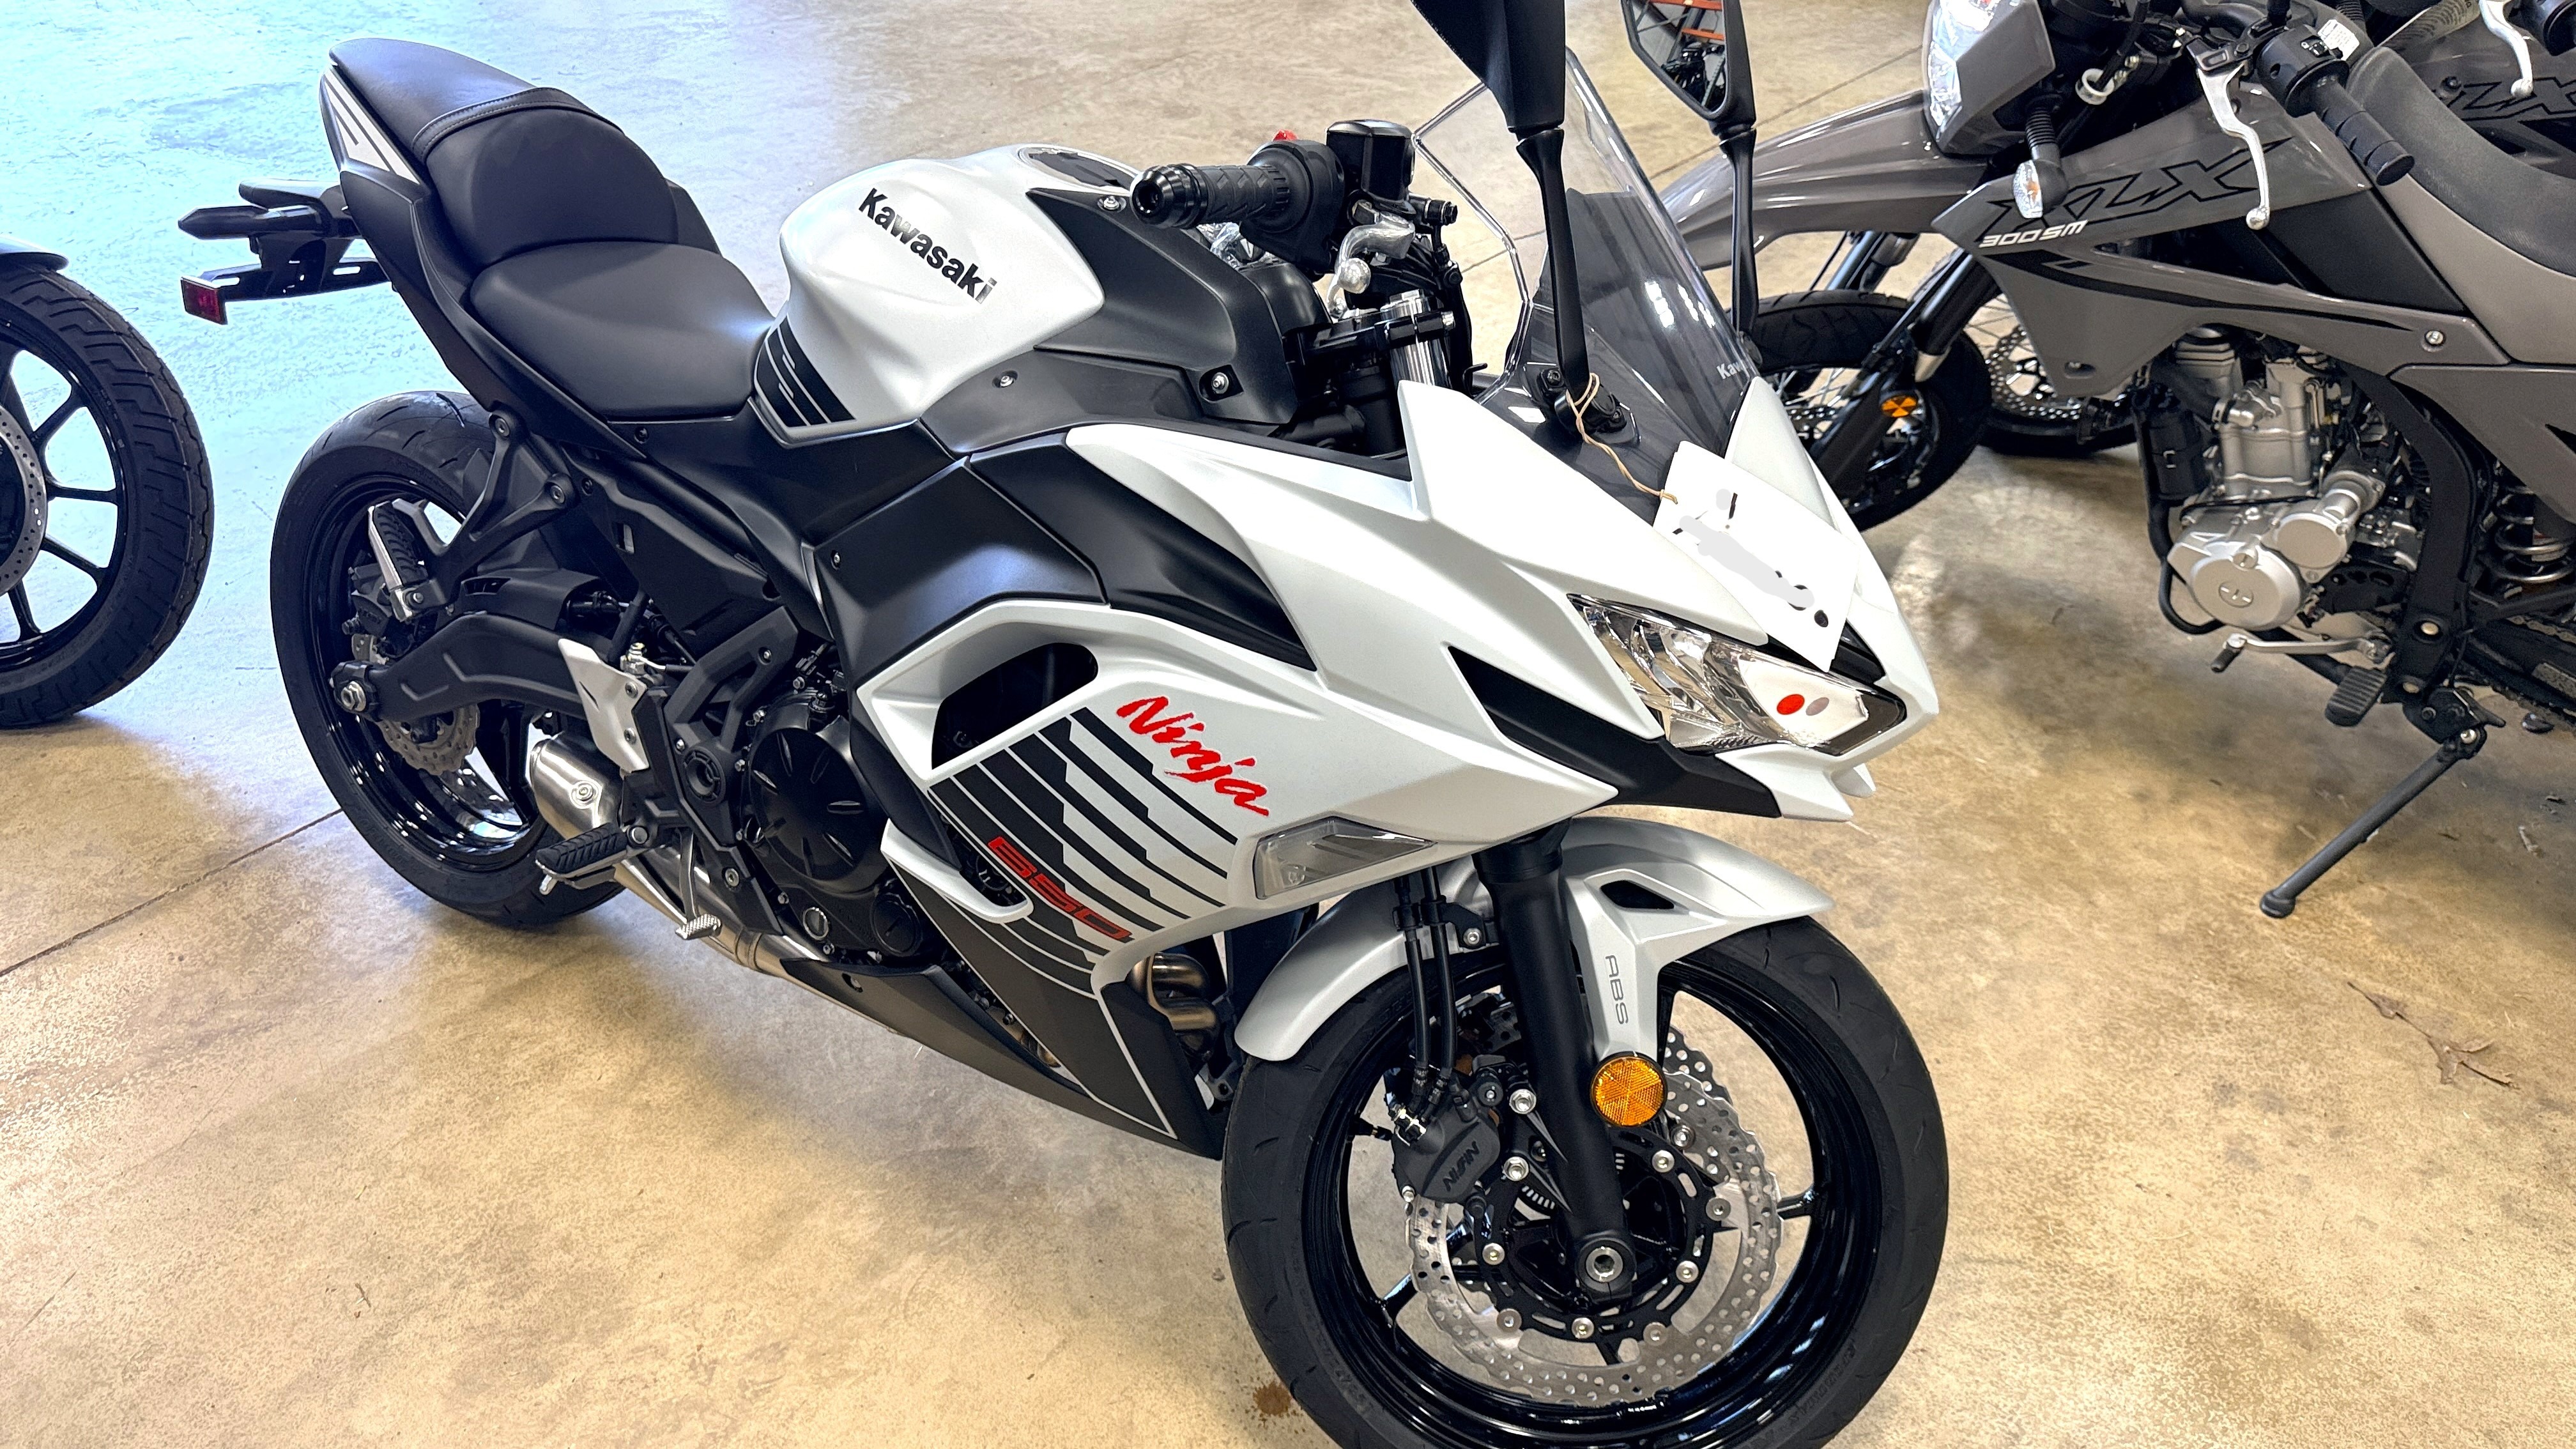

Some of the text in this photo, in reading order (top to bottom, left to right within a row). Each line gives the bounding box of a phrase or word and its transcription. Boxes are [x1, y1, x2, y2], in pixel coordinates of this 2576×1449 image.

[858, 187, 998, 305] Kawasaki
[1116, 696, 1269, 817] Ninja
[988, 836, 1133, 940] 650
[1604, 954, 1629, 1025] ABS
